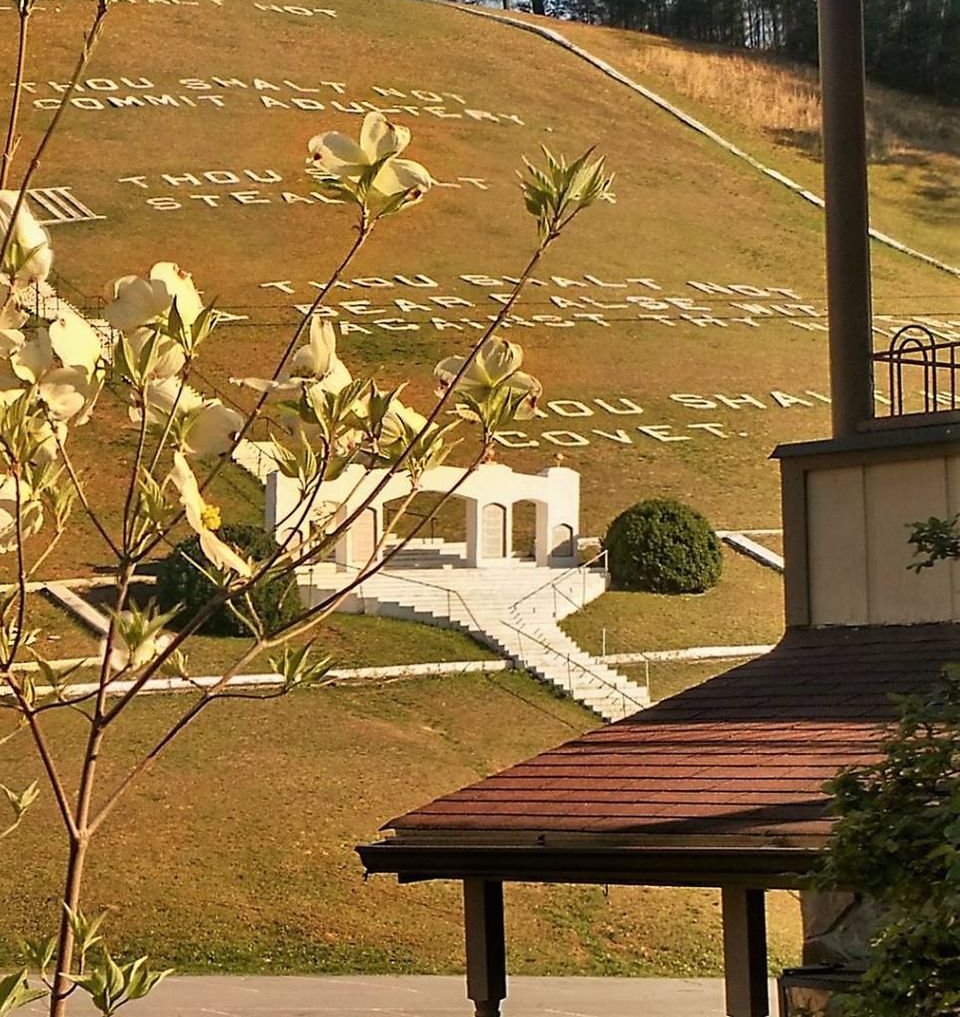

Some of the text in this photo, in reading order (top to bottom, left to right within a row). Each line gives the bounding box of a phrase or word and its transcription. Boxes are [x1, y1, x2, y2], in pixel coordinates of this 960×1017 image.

[254, 1, 337, 19] NOT
[10, 76, 466, 105] THOU SHALT NOT
[33, 94, 226, 111] COMMIT
[118, 168, 283, 189] THOU
[146, 190, 346, 211] STEAL
[261, 273, 802, 300] THOU SHALT NOT
[294, 295, 475, 318] BEAR
[488, 292, 713, 312] FALSE
[339, 312, 760, 336] AGAINST THY
